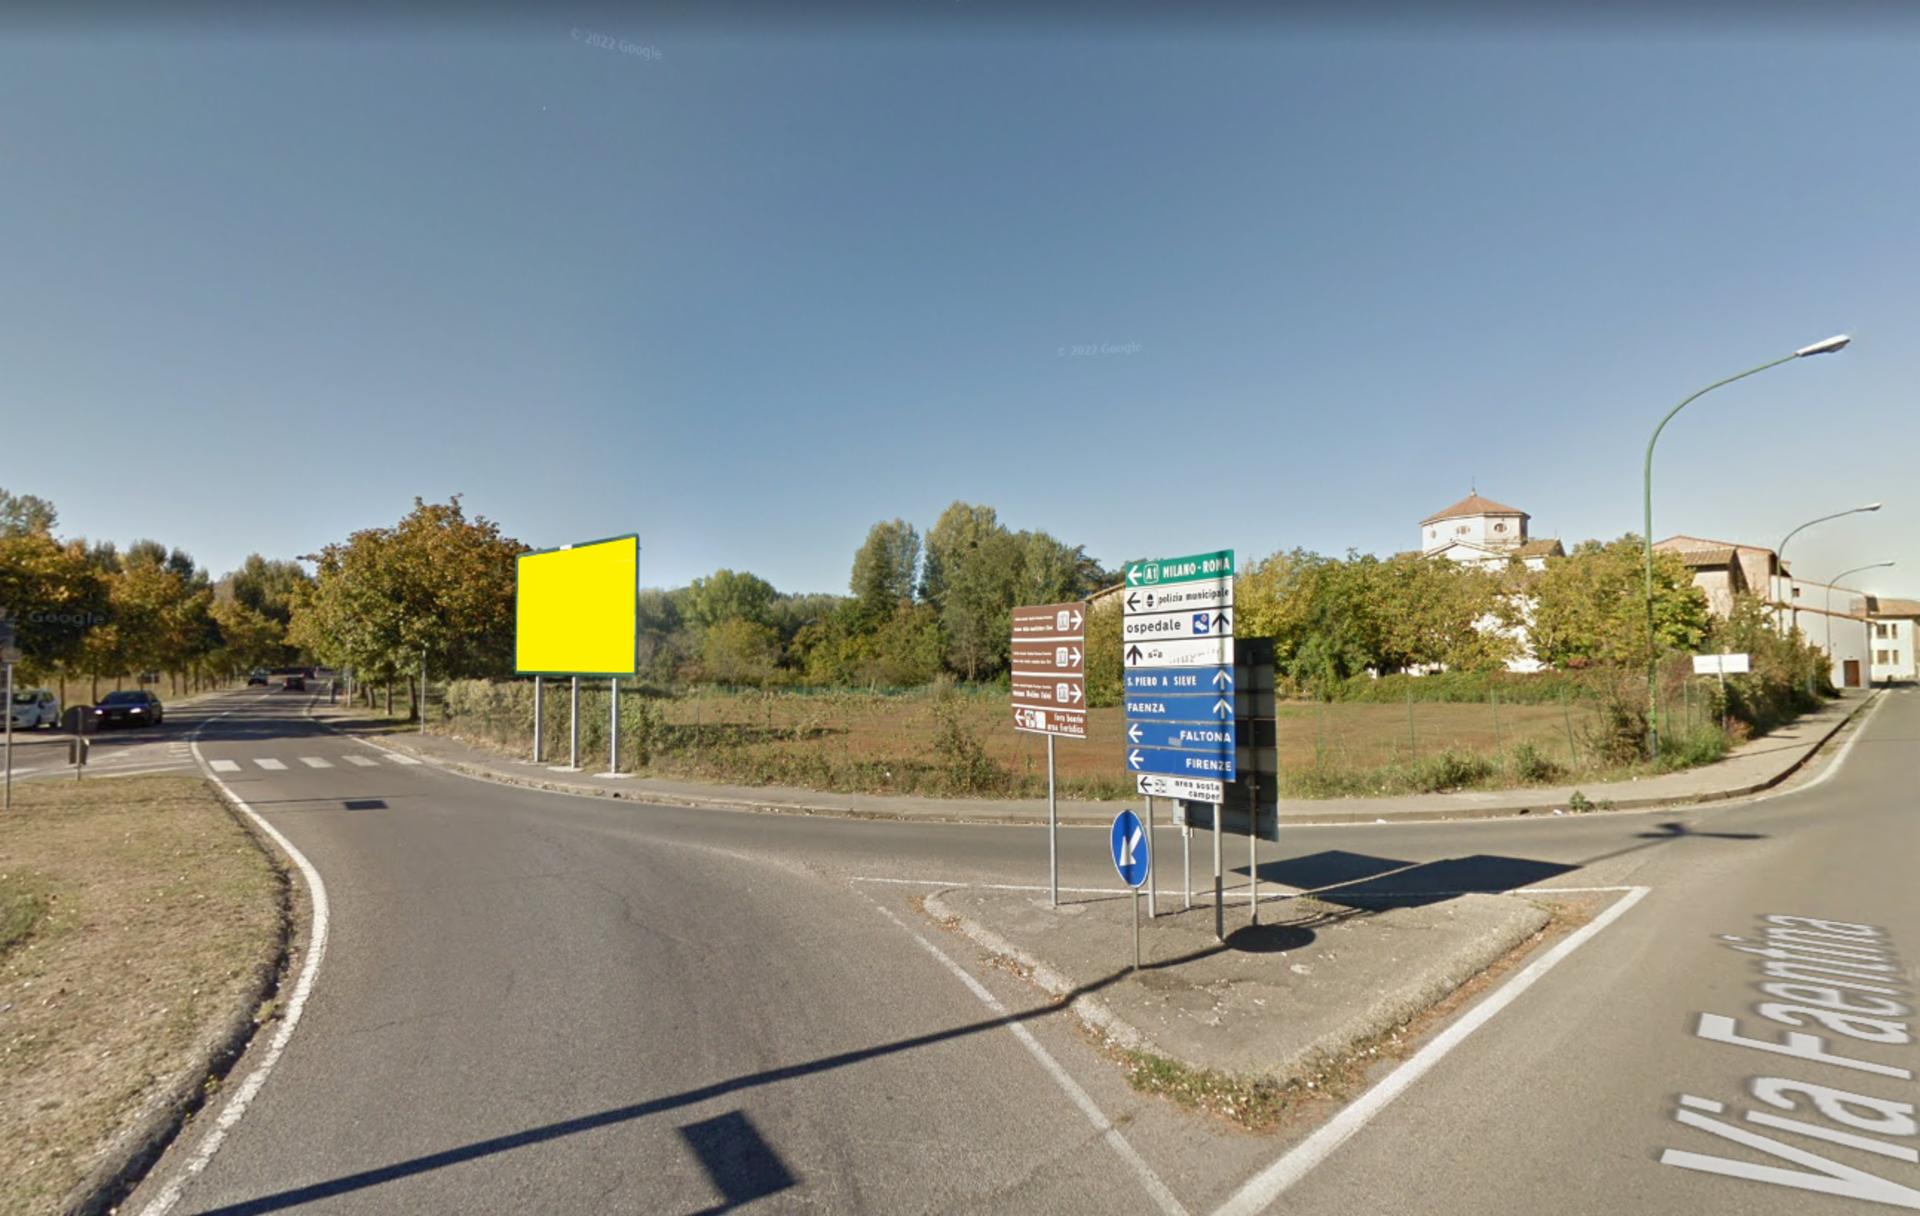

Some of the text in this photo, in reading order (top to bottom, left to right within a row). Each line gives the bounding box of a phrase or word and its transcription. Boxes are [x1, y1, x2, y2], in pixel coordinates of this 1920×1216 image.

[1158, 588, 1229, 605] polizia municipale
[1126, 619, 1182, 634] ospedale
[1135, 676, 1158, 687] PIERO
[1162, 676, 1168, 686] A
[1174, 675, 1197, 687] SIEVE
[1127, 702, 1166, 713] FAENZA
[1179, 729, 1232, 743] FALTONA
[1185, 758, 1232, 772] FIRENZE
[1174, 780, 1220, 791] area sosta
[1188, 788, 1220, 800] camper
